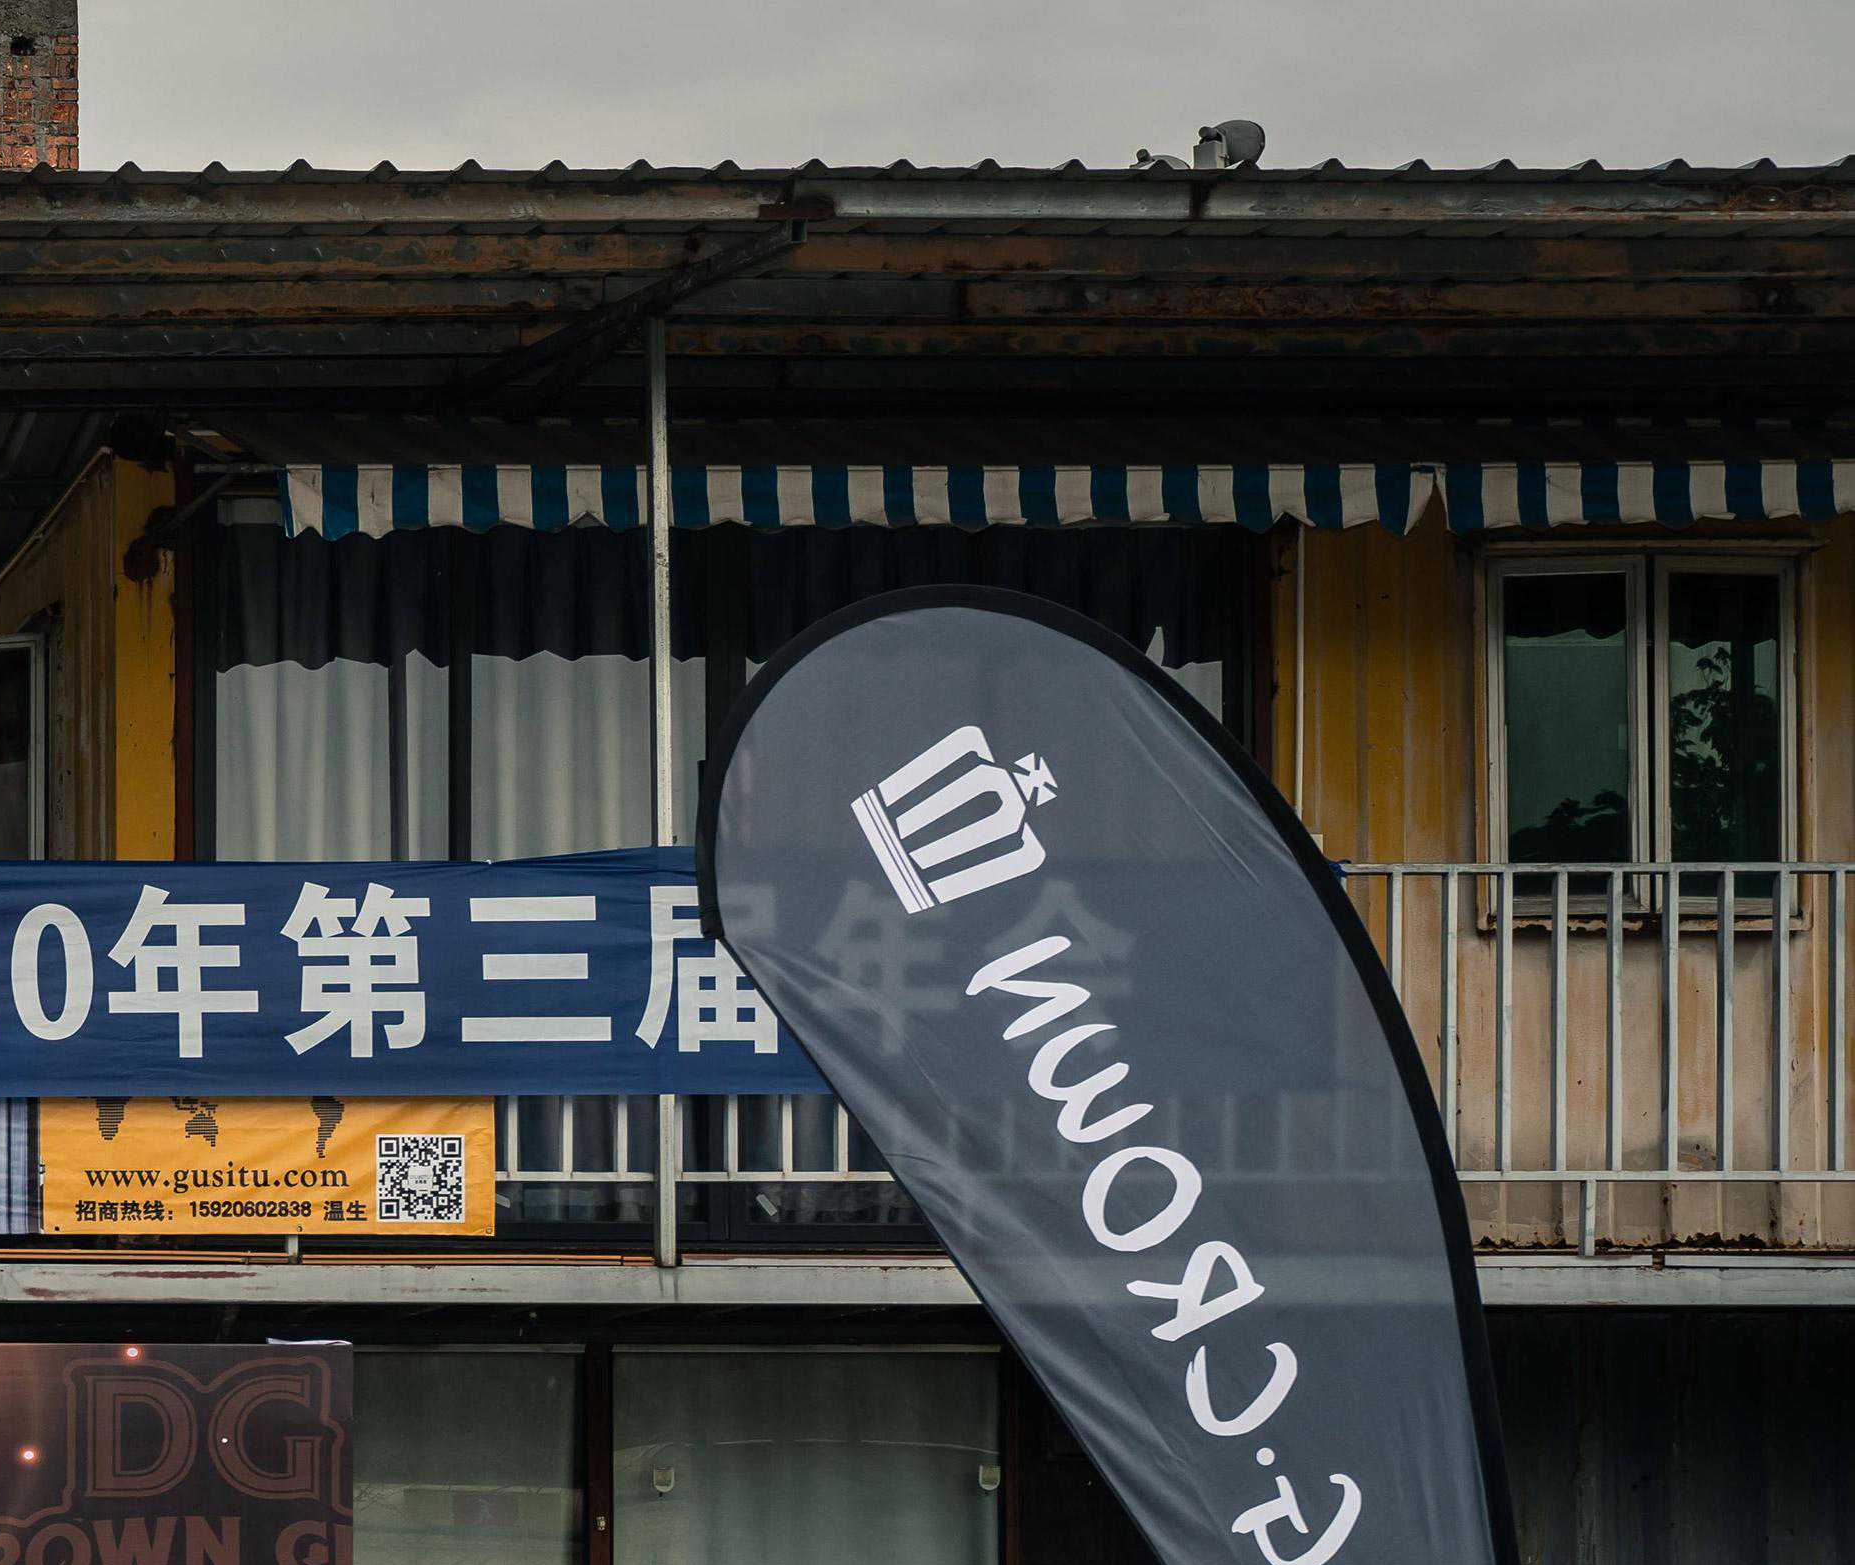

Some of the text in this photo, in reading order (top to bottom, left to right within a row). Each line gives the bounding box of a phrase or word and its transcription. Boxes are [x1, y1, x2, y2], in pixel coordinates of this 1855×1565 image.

[84, 1160, 351, 1194] www.gusitu.com
[189, 1200, 313, 1219] 15920602838
[323, 1200, 368, 1223] 温生
[85, 1372, 320, 1500] DG
